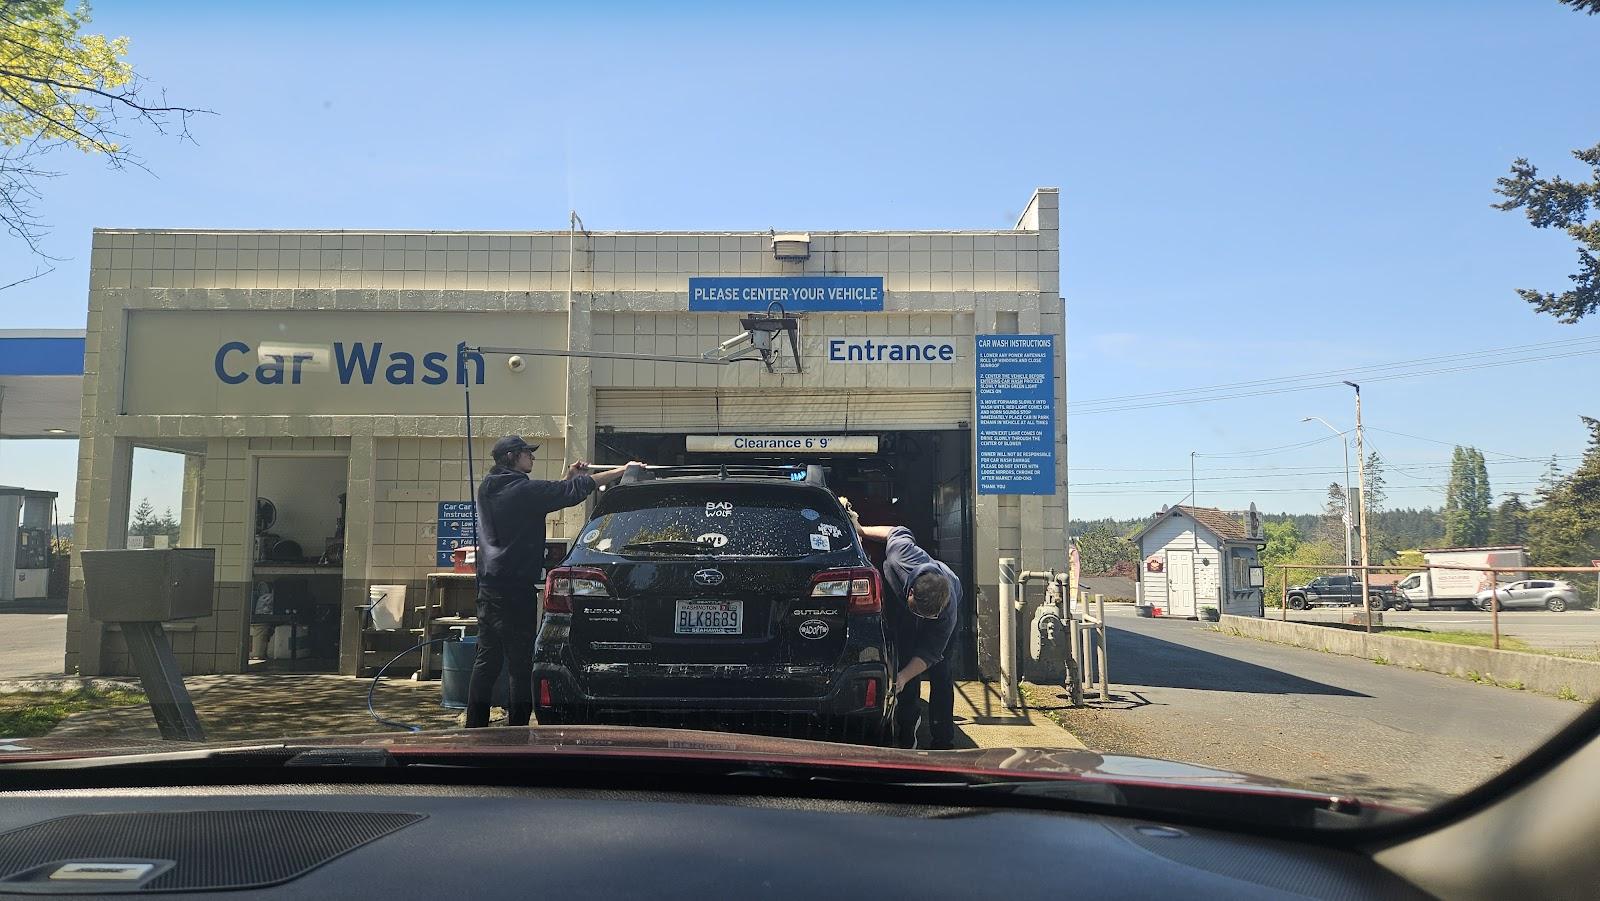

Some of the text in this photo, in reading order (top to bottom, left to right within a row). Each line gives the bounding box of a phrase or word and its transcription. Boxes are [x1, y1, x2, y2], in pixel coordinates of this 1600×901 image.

[694, 287, 878, 300] PLEASE CENTER YOUR VEHICLE
[978, 340, 1051, 348] CAR WASH INSTRUCTIONS
[830, 340, 954, 360] Entrance
[214, 341, 485, 384] Car Wash
[734, 438, 801, 448] Clearance
[805, 438, 816, 448] 6'
[706, 502, 733, 510] BAD
[705, 510, 732, 518] WOLF
[680, 611, 737, 626] BLK8689
